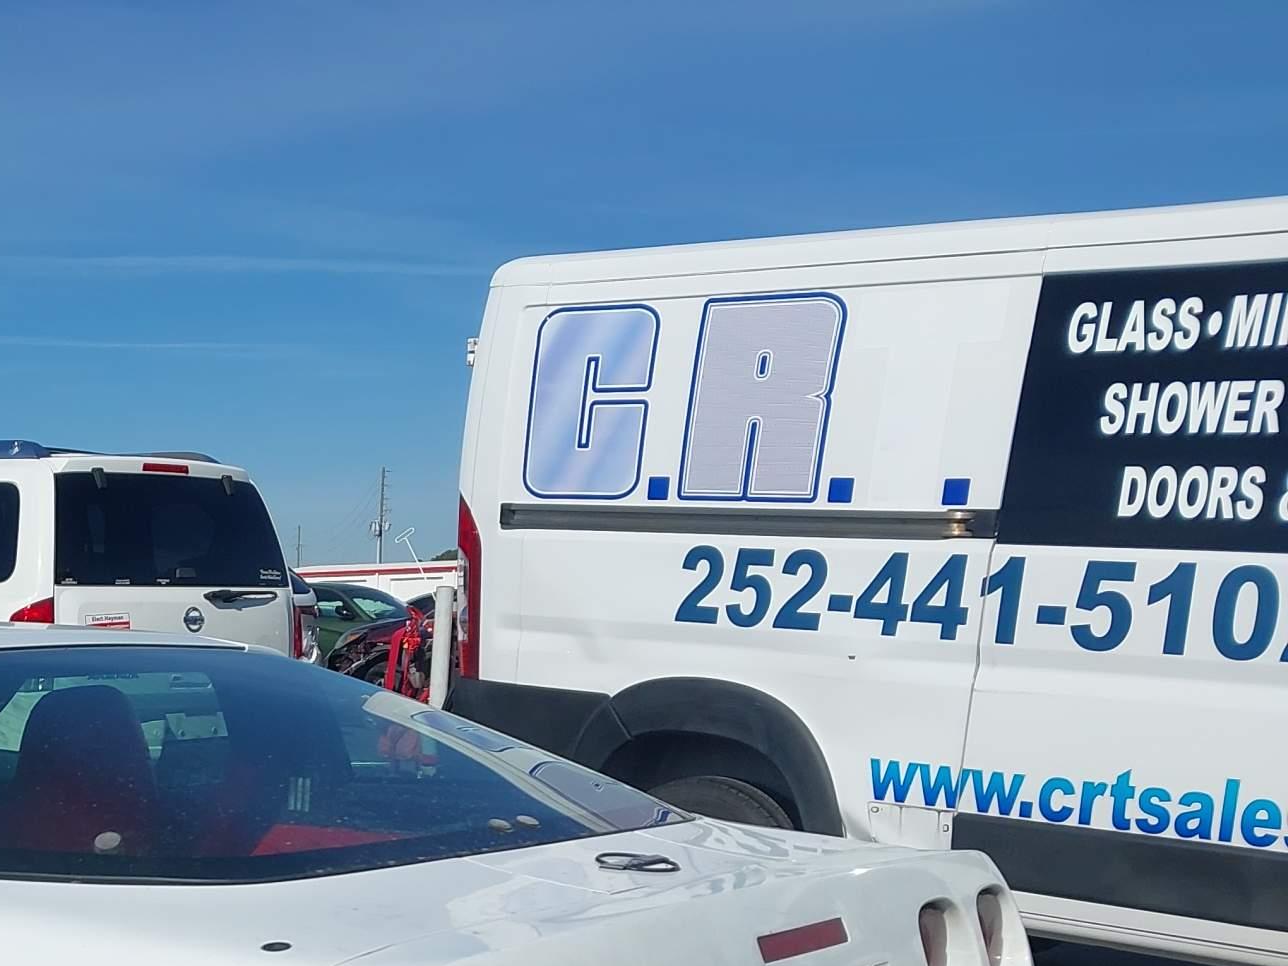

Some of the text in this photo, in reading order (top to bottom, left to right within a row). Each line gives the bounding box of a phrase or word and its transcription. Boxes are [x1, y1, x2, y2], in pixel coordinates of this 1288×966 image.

[1100, 380, 1285, 434] SHOWER
[1117, 465, 1266, 520] DOORS
[674, 544, 1288, 663] 252-441-510
[869, 756, 1288, 848] www.crtsale
